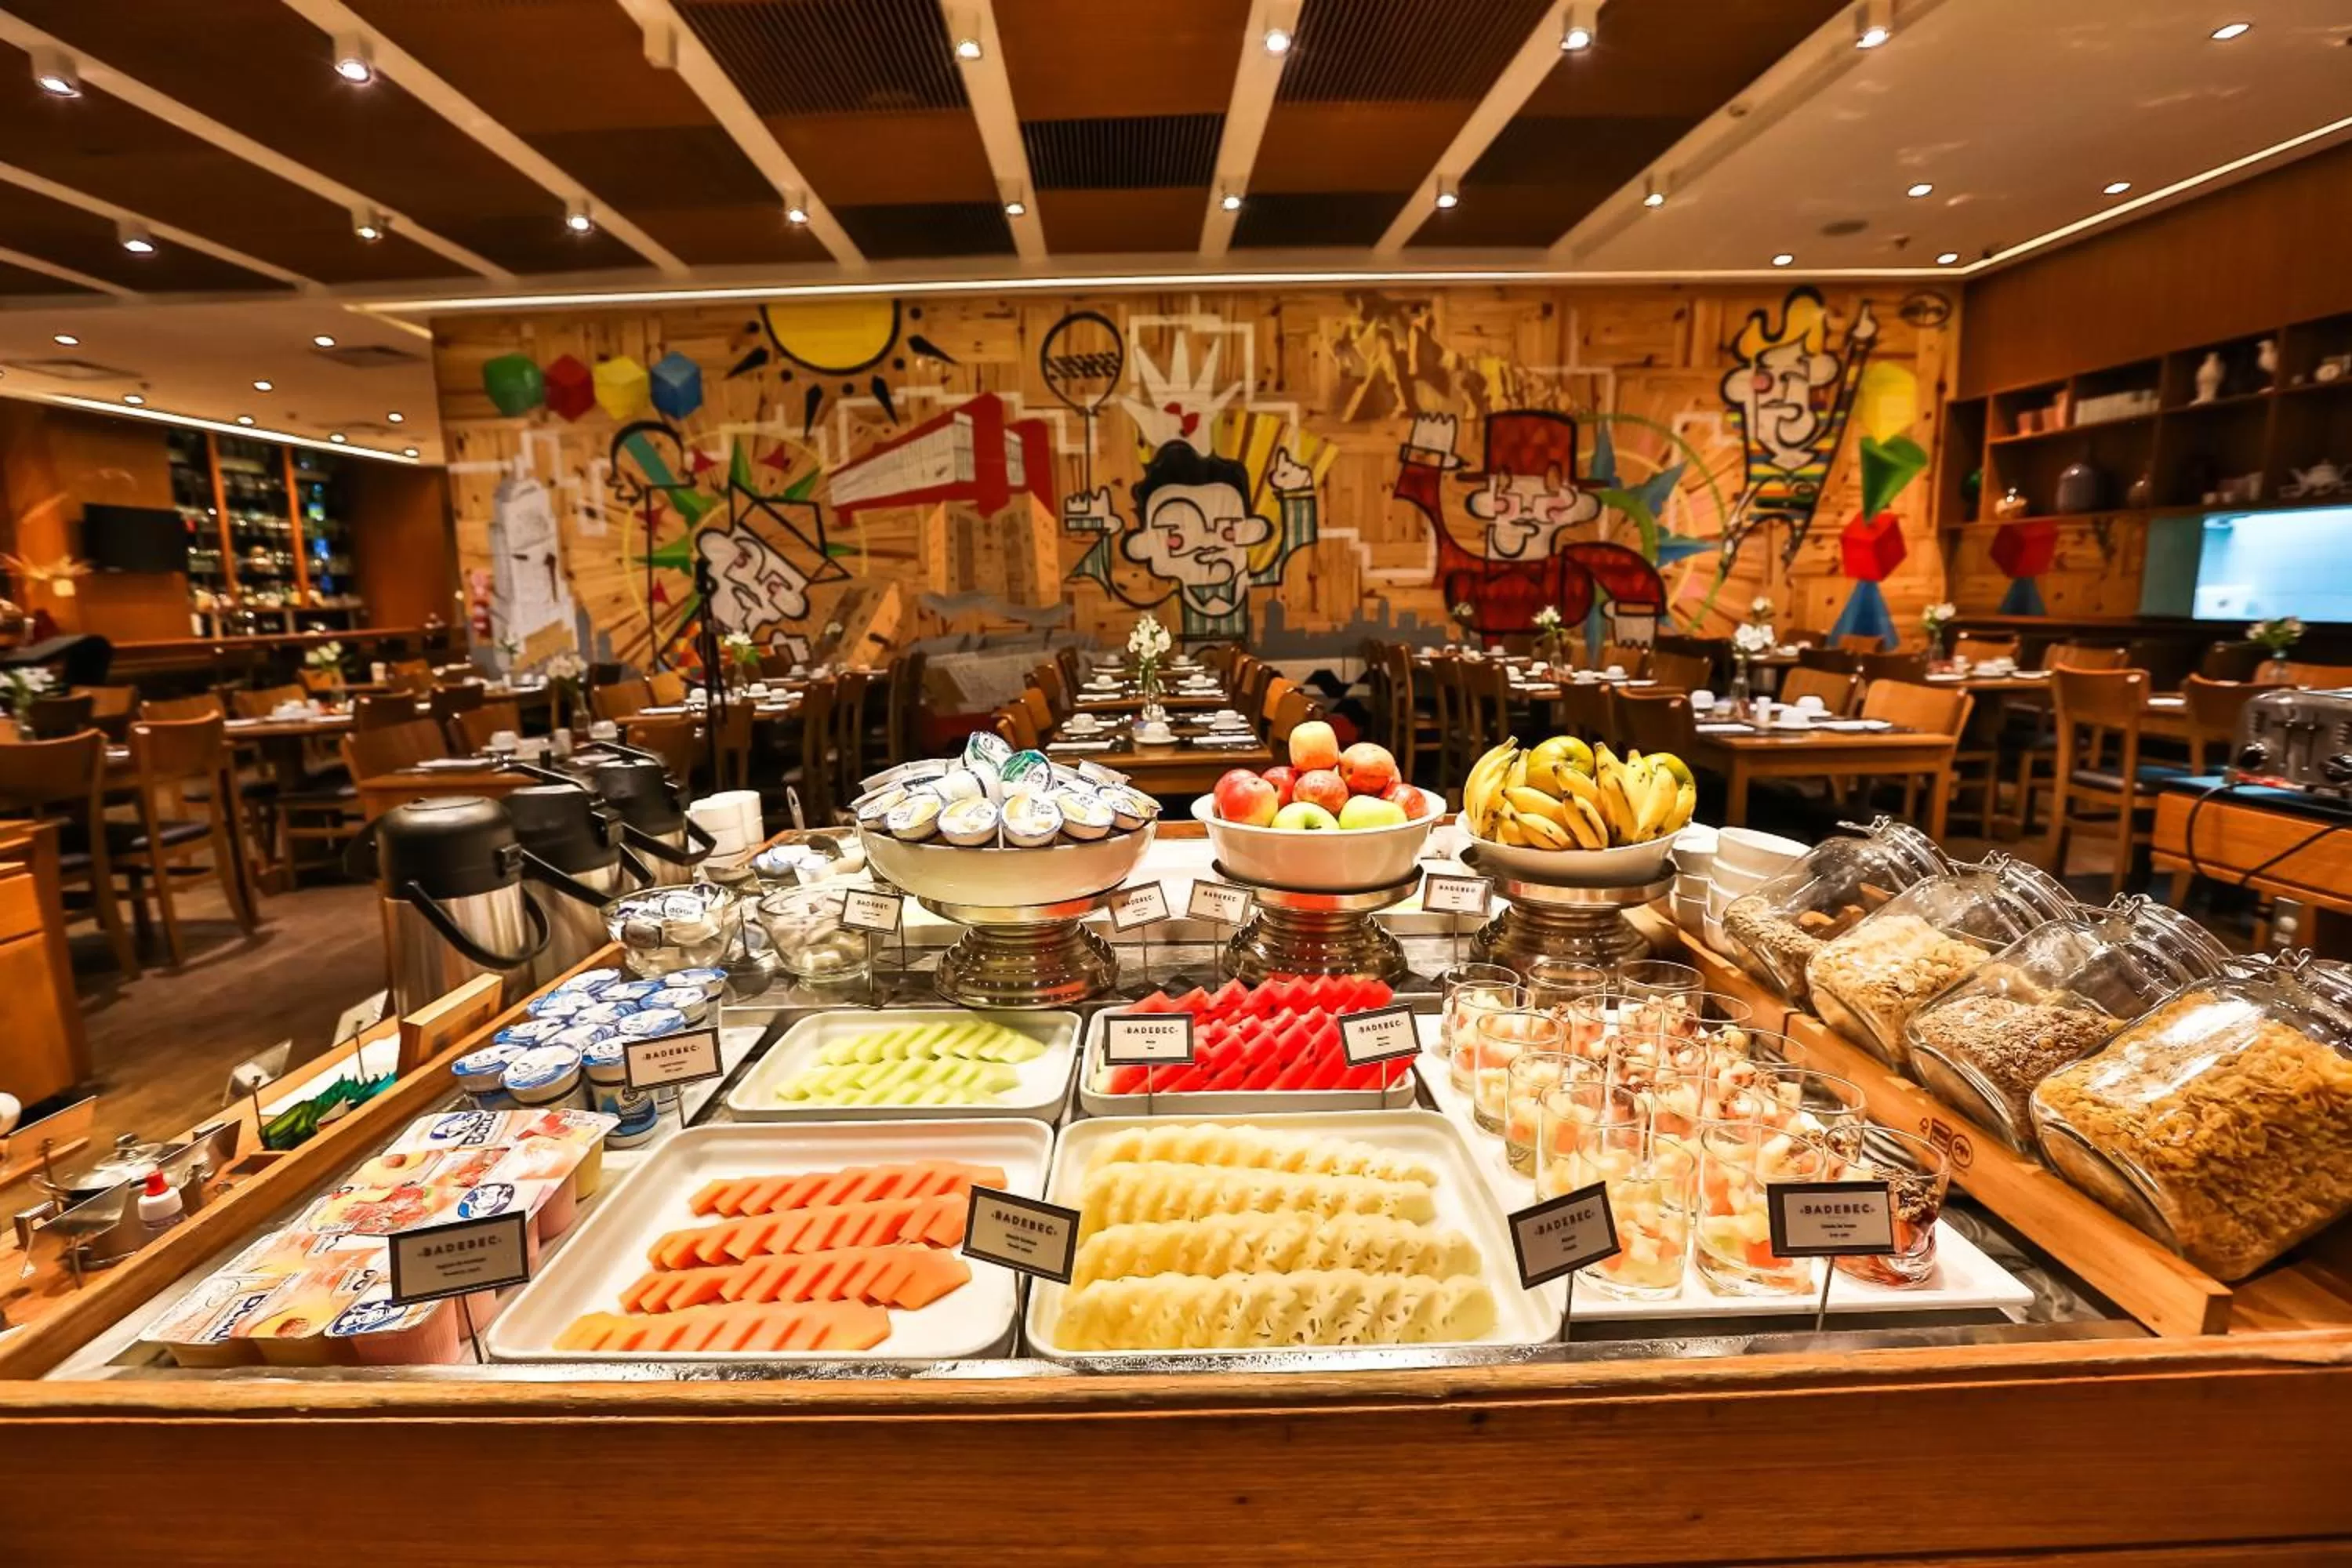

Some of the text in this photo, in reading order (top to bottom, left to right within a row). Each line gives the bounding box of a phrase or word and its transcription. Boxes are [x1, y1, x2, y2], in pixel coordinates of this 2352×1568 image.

[645, 1044, 697, 1060] BADEBEC
[1804, 1203, 1870, 1214] BADEBEC
[995, 1210, 1054, 1236] BADEBEC
[1538, 1210, 1592, 1235] BADEBEC
[423, 1235, 497, 1257] BADEBEC
